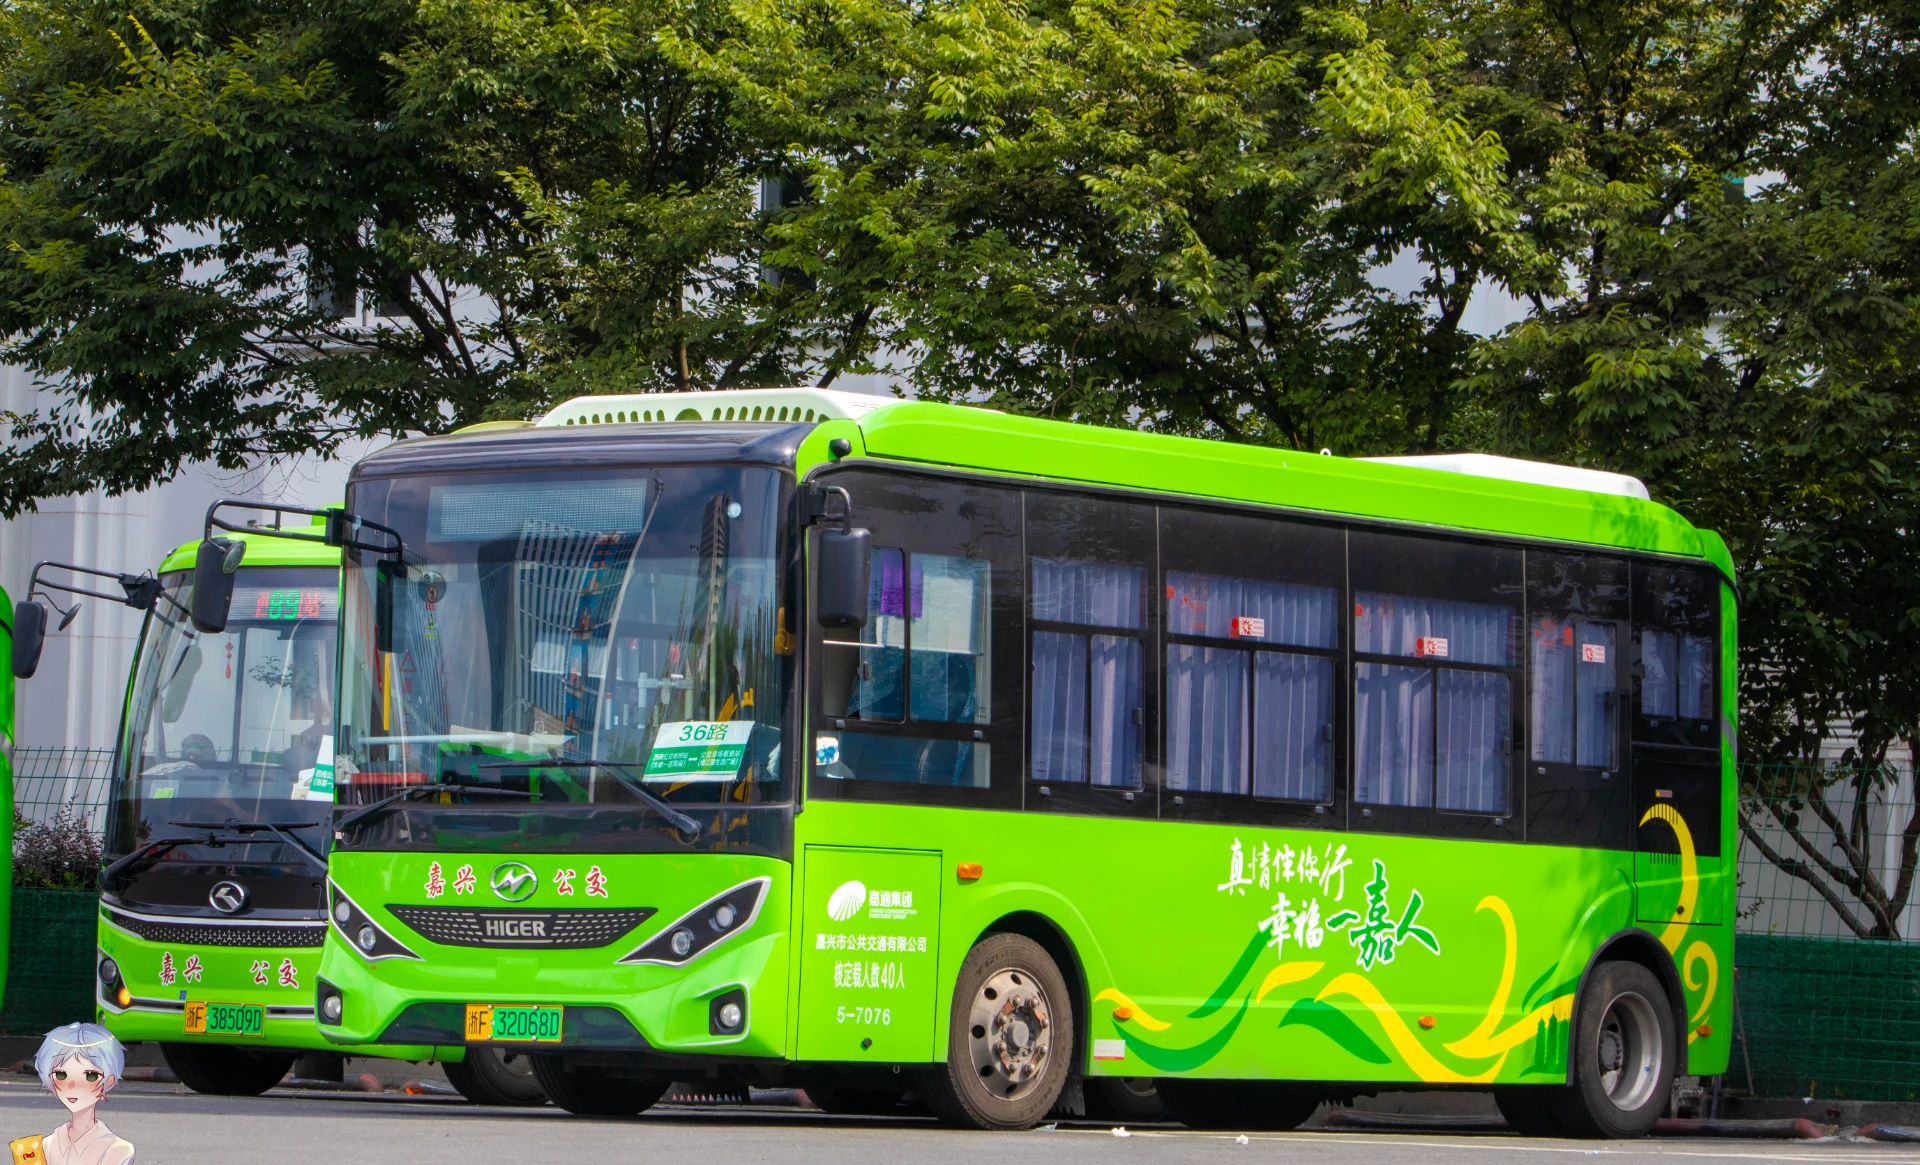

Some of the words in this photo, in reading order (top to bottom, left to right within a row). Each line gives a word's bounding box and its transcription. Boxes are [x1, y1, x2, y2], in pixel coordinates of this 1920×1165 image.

[679, 723, 728, 742] 36路
[424, 861, 477, 898] 嘉兴
[553, 865, 609, 899] 公交
[1217, 837, 1353, 901] 真情伴你行
[868, 890, 913, 908] 嘉通集团
[1257, 859, 1441, 972] 幸福一嘉人
[485, 920, 547, 937] HIGER
[815, 933, 927, 953] 嘉兴市公共交通有限公司
[159, 951, 204, 986] 嘉兴
[250, 958, 300, 989] 公交
[833, 960, 905, 989] 核定载人数40人
[837, 1006, 891, 1026] 5-7076
